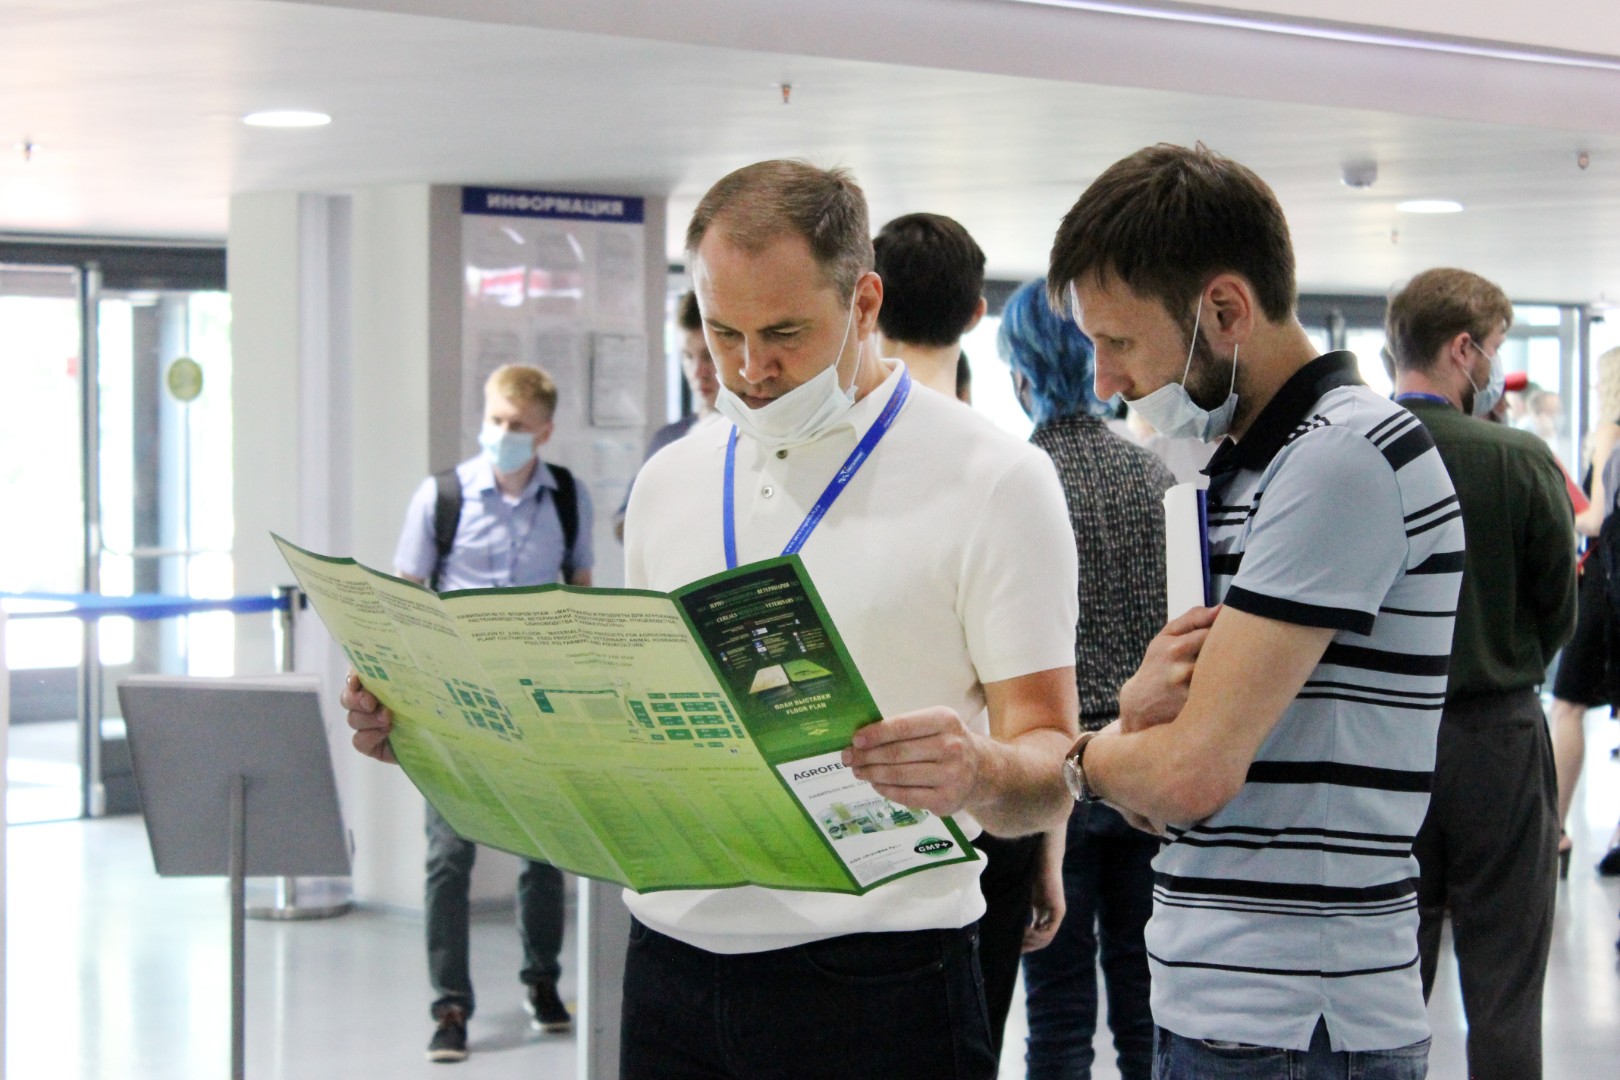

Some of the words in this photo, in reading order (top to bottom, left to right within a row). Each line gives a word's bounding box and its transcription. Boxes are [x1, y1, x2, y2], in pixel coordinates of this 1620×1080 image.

[486, 193, 624, 217] ИНФОРМАЦИЯ
[774, 701, 794, 711] ПЛАН
[794, 693, 832, 706] ВЫСТАВКИ
[786, 705, 809, 715] FLOOR
[808, 702, 827, 711] PLAN
[918, 841, 949, 853] GMP+
